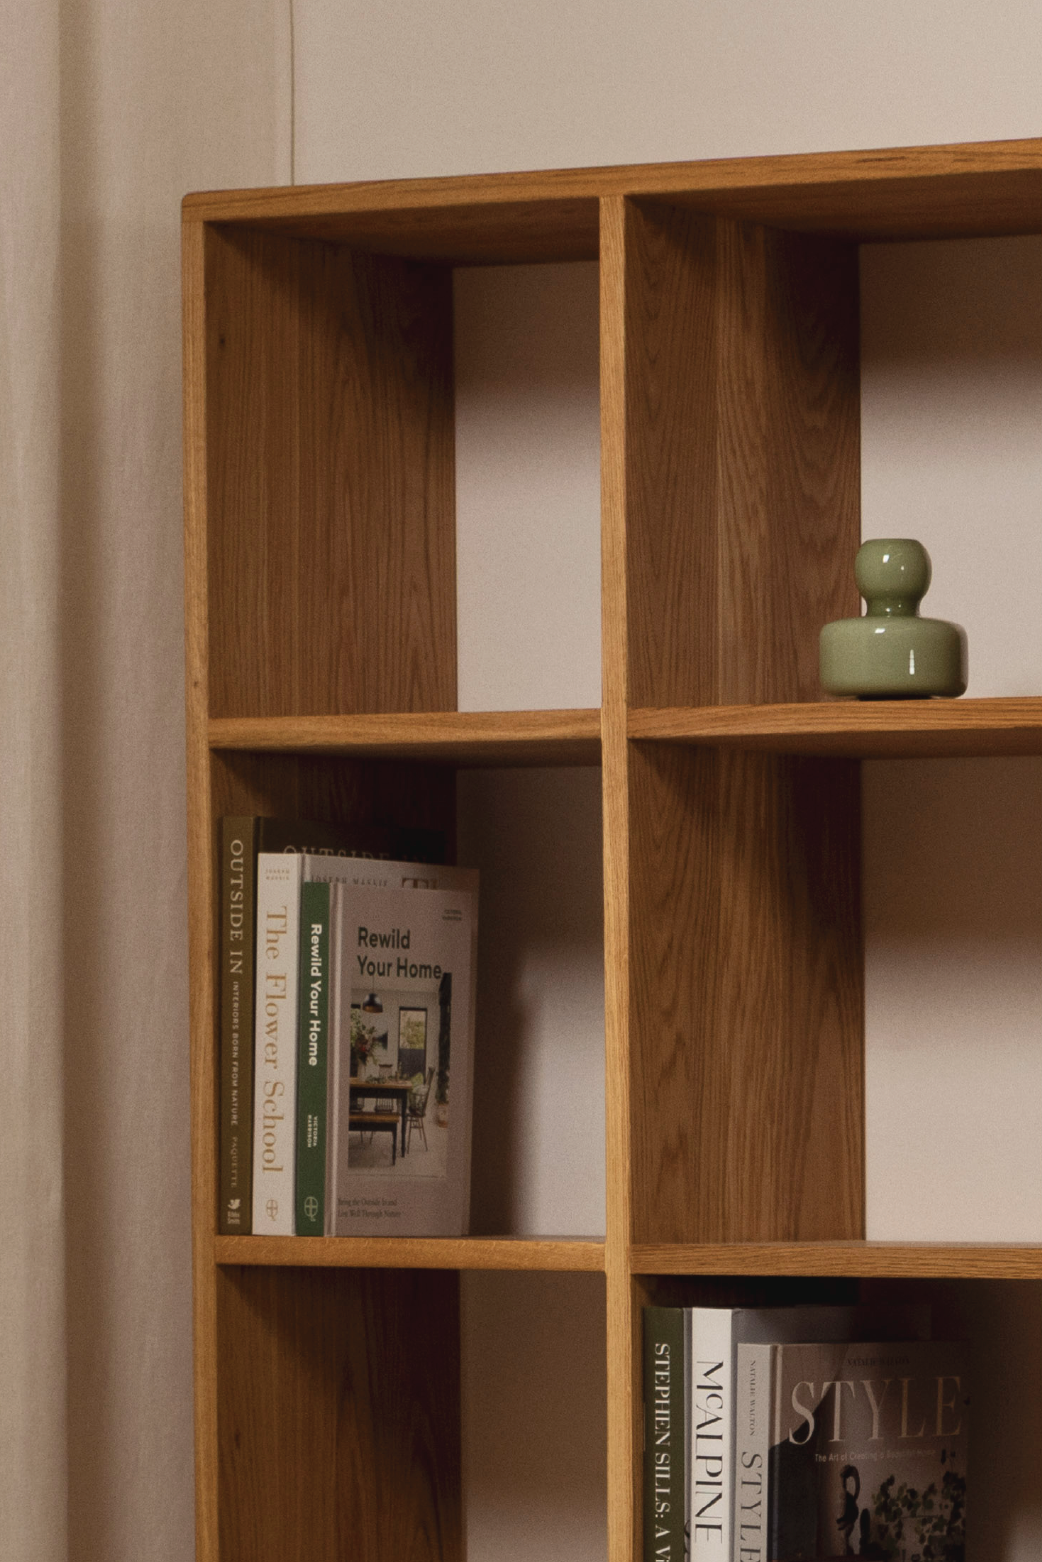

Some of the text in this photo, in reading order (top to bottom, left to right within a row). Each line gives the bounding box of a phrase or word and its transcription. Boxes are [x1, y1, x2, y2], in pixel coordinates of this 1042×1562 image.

[229, 839, 244, 975] OUTSIDE IN
[357, 926, 410, 950] Rewild
[308, 923, 323, 1067] Rewild Your Home
[357, 955, 442, 980] Your Home
[230, 981, 240, 1126] INTERIORS BORN FROM NATURE
[262, 905, 288, 1174] The Flower School
[654, 1342, 671, 1447] STEPHEN
[788, 1375, 963, 1446] STYLE
[654, 1452, 671, 1519] SILLS:
[655, 1524, 671, 1539] A
